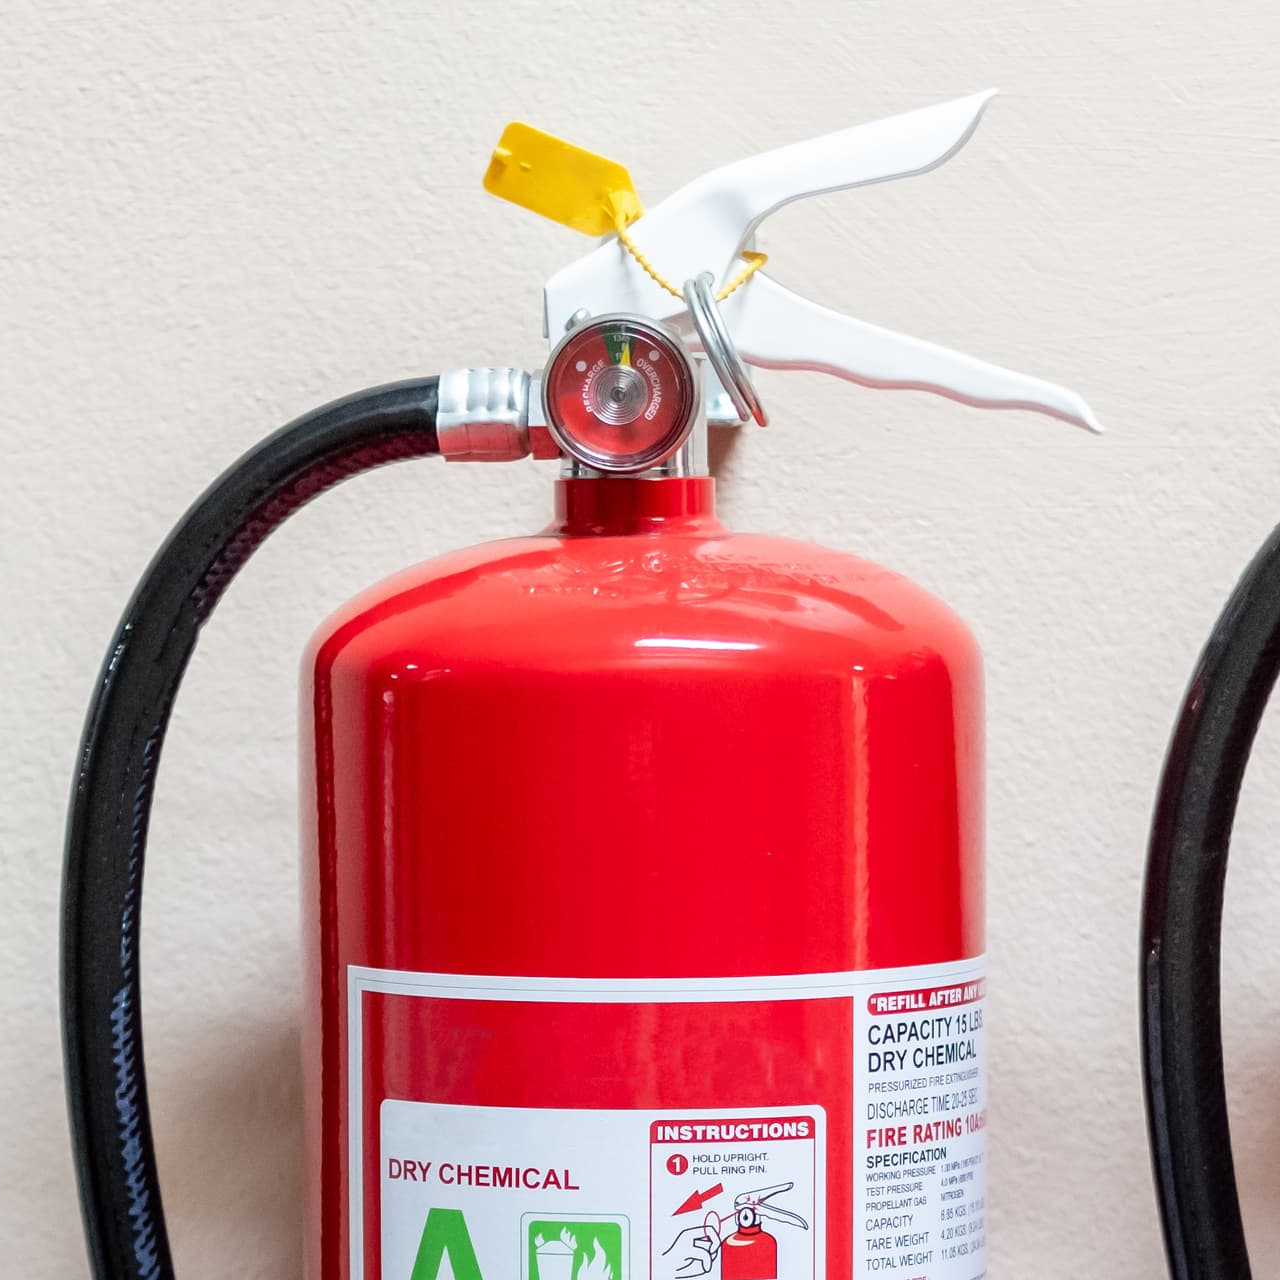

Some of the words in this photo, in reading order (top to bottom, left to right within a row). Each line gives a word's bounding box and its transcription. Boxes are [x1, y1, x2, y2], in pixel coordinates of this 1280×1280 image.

[636, 358, 661, 421] OVERCHARGED
[929, 988, 961, 1007] AFTER
[964, 984, 977, 1001] ANY
[868, 1016, 952, 1045] CAPACITY
[956, 1014, 967, 1034] 15
[868, 1049, 908, 1073] DRY
[913, 1039, 976, 1068] CHEMICAL
[868, 1077, 927, 1093] PRESSURIZED
[929, 1075, 944, 1087] FIRE
[867, 1097, 928, 1120] DISCHARGE
[931, 1094, 950, 1112] TIME
[951, 1090, 967, 1110] 20-25
[657, 1122, 809, 1140] INSTRUCTIONS
[867, 1126, 907, 1149] FIRE
[913, 1117, 962, 1144] RATING
[672, 1157, 680, 1172] 1
[693, 1154, 720, 1162] HOLD
[723, 1153, 769, 1162] UPRIGHT.
[866, 1147, 947, 1169] SPECIFICATION
[388, 1158, 431, 1182] DRY
[439, 1163, 580, 1190] CHEMICAL
[693, 1166, 718, 1175] PULL
[721, 1166, 746, 1174] RING
[749, 1165, 767, 1173] PIN.
[866, 1170, 901, 1182] WORKING
[903, 1166, 936, 1179] PRESSURE
[866, 1187, 884, 1197] TEST
[887, 1182, 923, 1194] PRESSURE
[866, 1198, 912, 1212] PROPELLANT
[914, 1196, 926, 1206] GAS
[866, 1214, 913, 1231] CAPACITY
[866, 1238, 892, 1251] TARE
[894, 1232, 930, 1248] WEIGHT
[866, 1258, 897, 1271] TOTAL
[900, 1250, 933, 1267] WEIGHT
